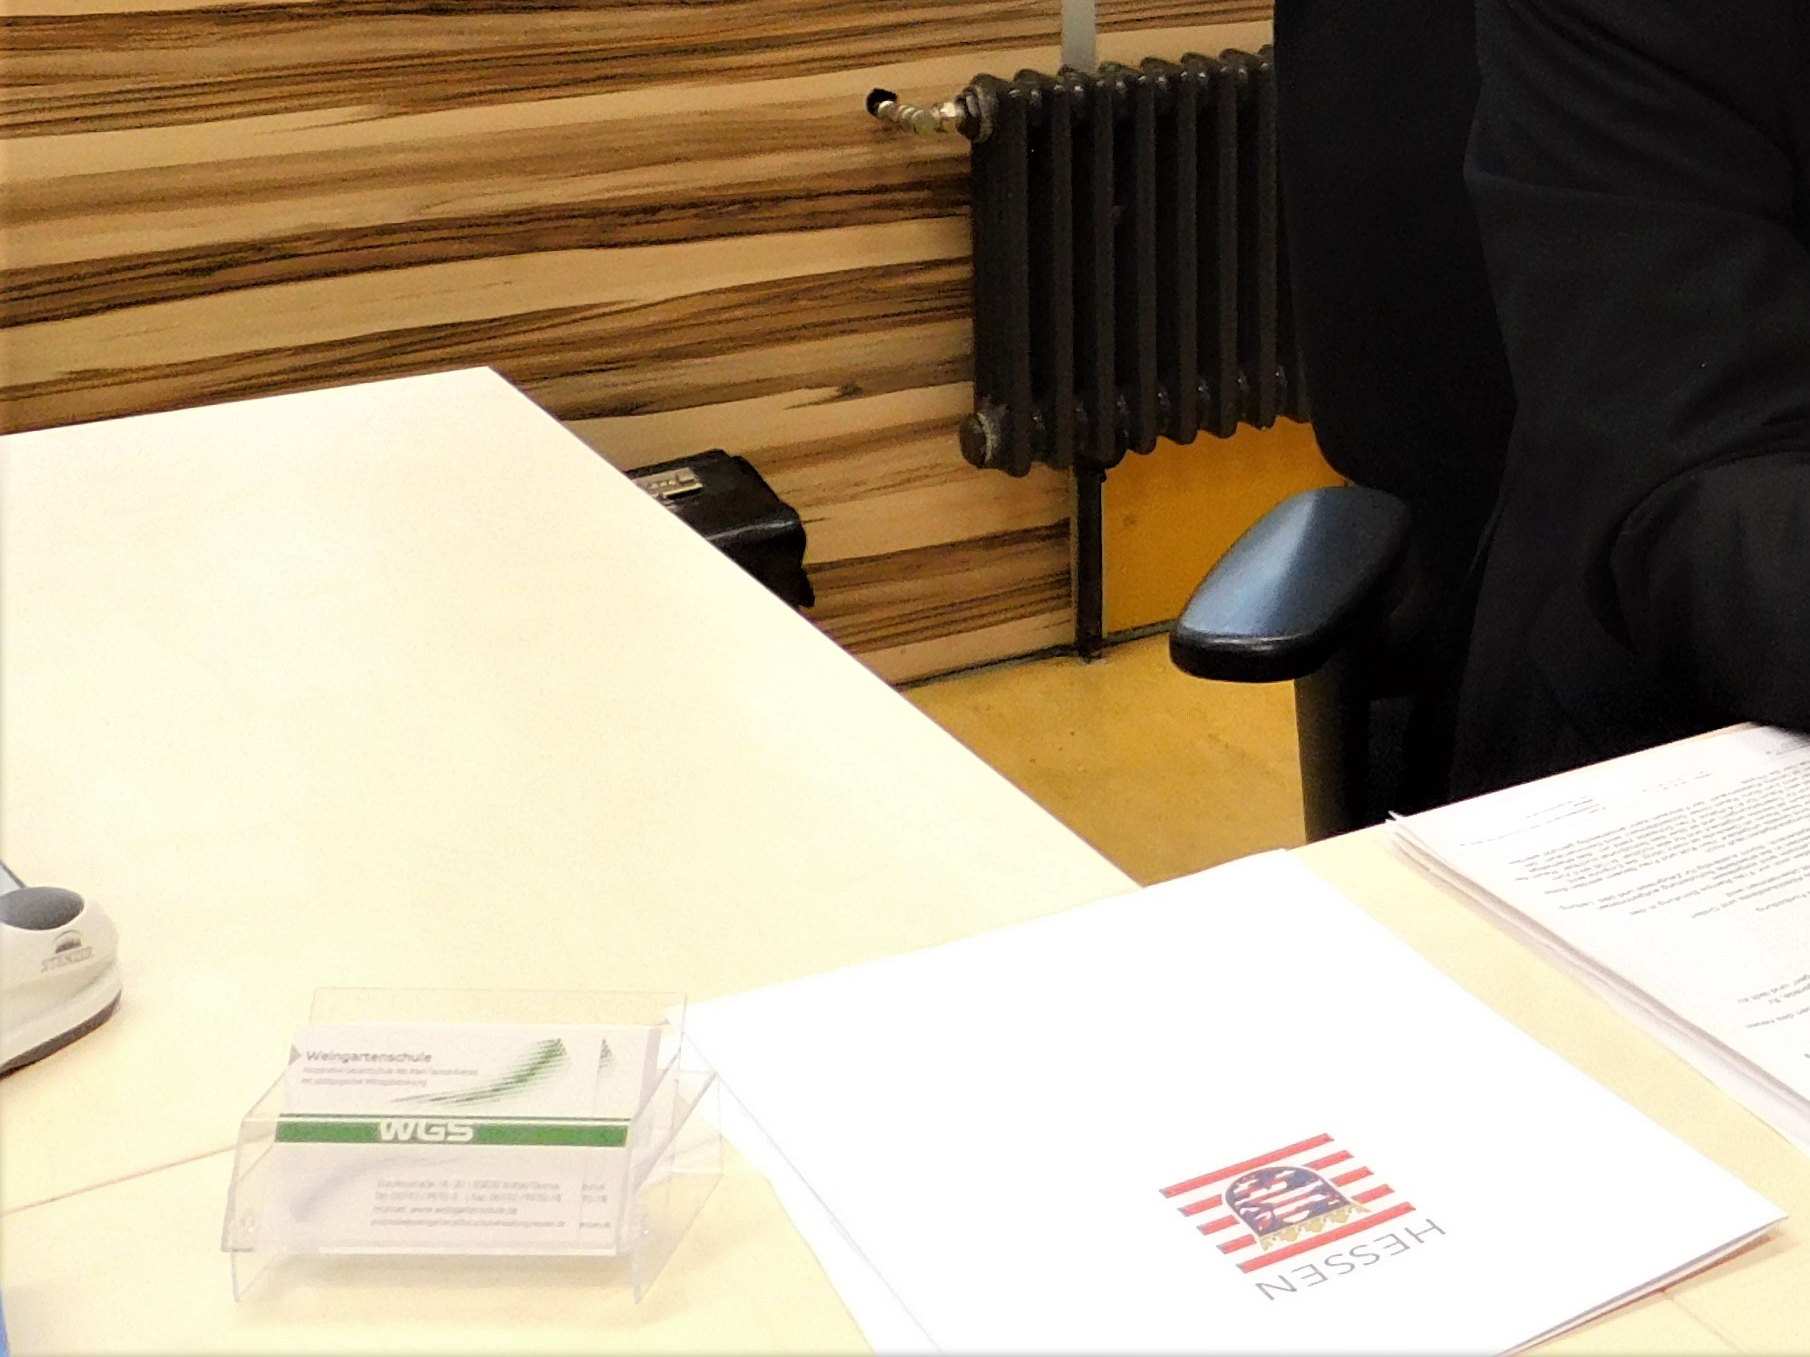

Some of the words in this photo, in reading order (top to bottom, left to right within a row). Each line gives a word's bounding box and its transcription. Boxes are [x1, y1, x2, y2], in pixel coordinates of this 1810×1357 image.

[306, 1049, 432, 1064] Weingartenschule
[378, 1119, 476, 1143] WGS
[1254, 1217, 1446, 1301] HESSEN
